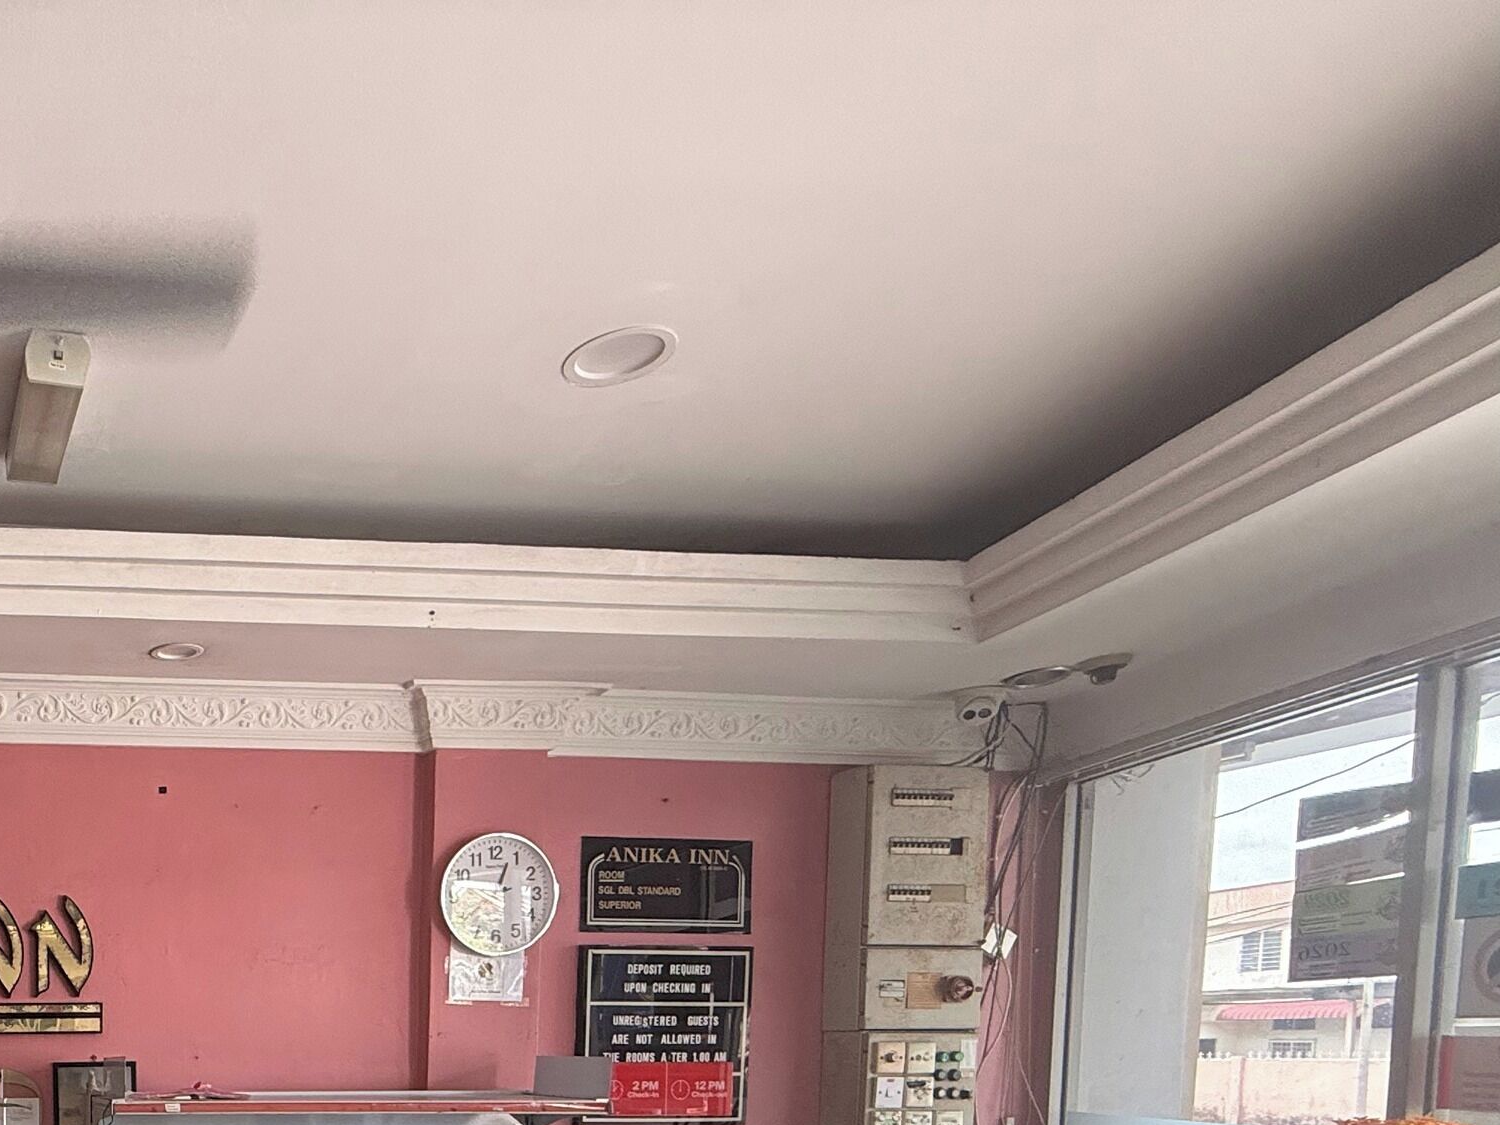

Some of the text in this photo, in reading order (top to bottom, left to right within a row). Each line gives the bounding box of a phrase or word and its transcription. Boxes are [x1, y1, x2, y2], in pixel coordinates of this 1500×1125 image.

[488, 845, 503, 860] 12
[513, 851, 519, 865] 1
[606, 846, 730, 865] ANIKA INN
[470, 853, 482, 867] 11
[455, 869, 470, 881] 10
[526, 867, 536, 881] 2
[599, 870, 625, 880] ROOM
[532, 887, 542, 901] 3
[598, 886, 682, 896] SGL DBL STANDARD
[598, 900, 642, 910] SUPERIOR
[491, 929, 501, 943] 6
[511, 924, 521, 938] 5
[627, 963, 711, 976] DEPOSIT REQUIRED
[623, 982, 711, 993] UPON CHECKING IN
[612, 1015, 719, 1027] UNREGISTERED GUESTS
[612, 1034, 717, 1045] ARE NOT ALLOWED IN
[626, 1052, 655, 1063] ROOMS
[661, 1052, 688, 1063] ATER
[713, 1052, 727, 1062] AM
[632, 1081, 659, 1091] 2 PM
[694, 1081, 725, 1091] 12 PM
